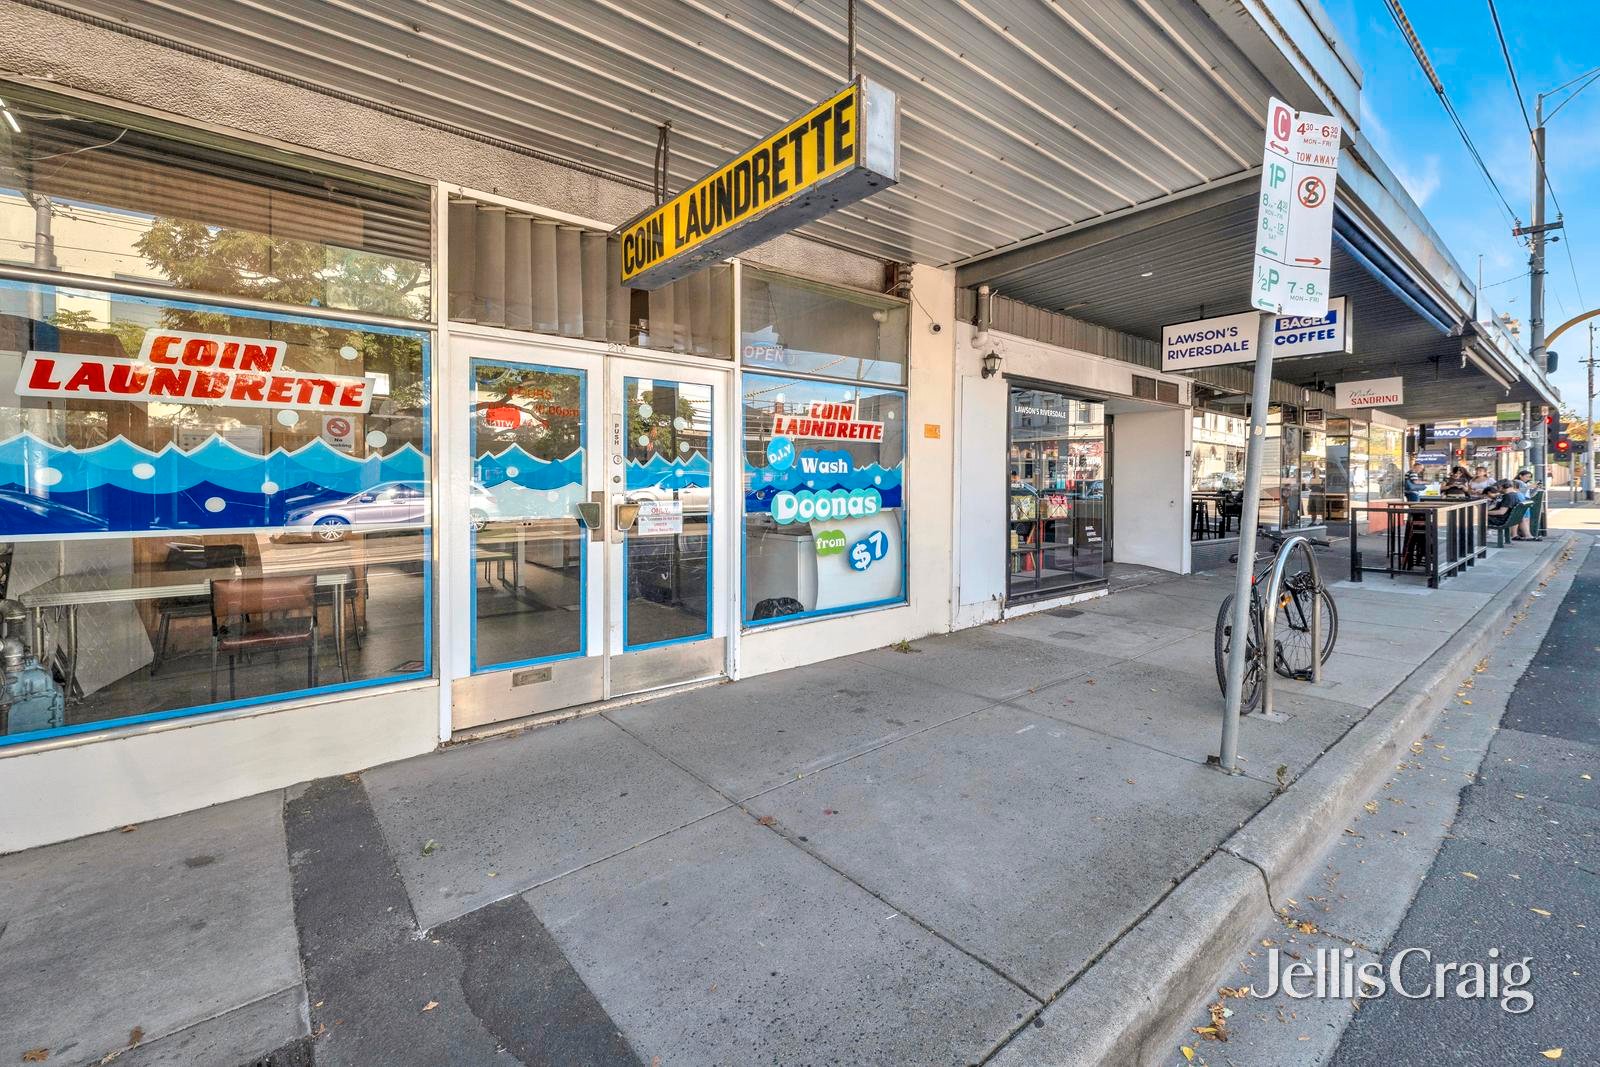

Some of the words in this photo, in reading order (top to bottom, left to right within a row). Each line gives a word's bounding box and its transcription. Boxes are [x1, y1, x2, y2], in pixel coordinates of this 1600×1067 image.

[1296, 152, 1312, 162] TOW
[1314, 154, 1336, 165] AWAY
[623, 211, 664, 275] COIN
[675, 94, 855, 249] LAUNDRETTE
[1270, 163, 1286, 189] 1P
[1168, 327, 1238, 346] LAWSON'S
[1274, 329, 1335, 345] COFFEE
[149, 334, 278, 372] COIN
[744, 345, 784, 361] OPEN
[1168, 340, 1249, 360] RIVERSDALE
[28, 358, 366, 407] LAUNDRETTE
[1351, 395, 1398, 405] SANDRINO
[811, 403, 852, 420] COIN
[1040, 408, 1066, 419] RIVERSDALE
[775, 418, 882, 439] LAUNDRETTE
[801, 457, 849, 474] Wash
[777, 494, 877, 519] Doonas
[816, 538, 845, 549] from
[852, 532, 883, 570] $7
